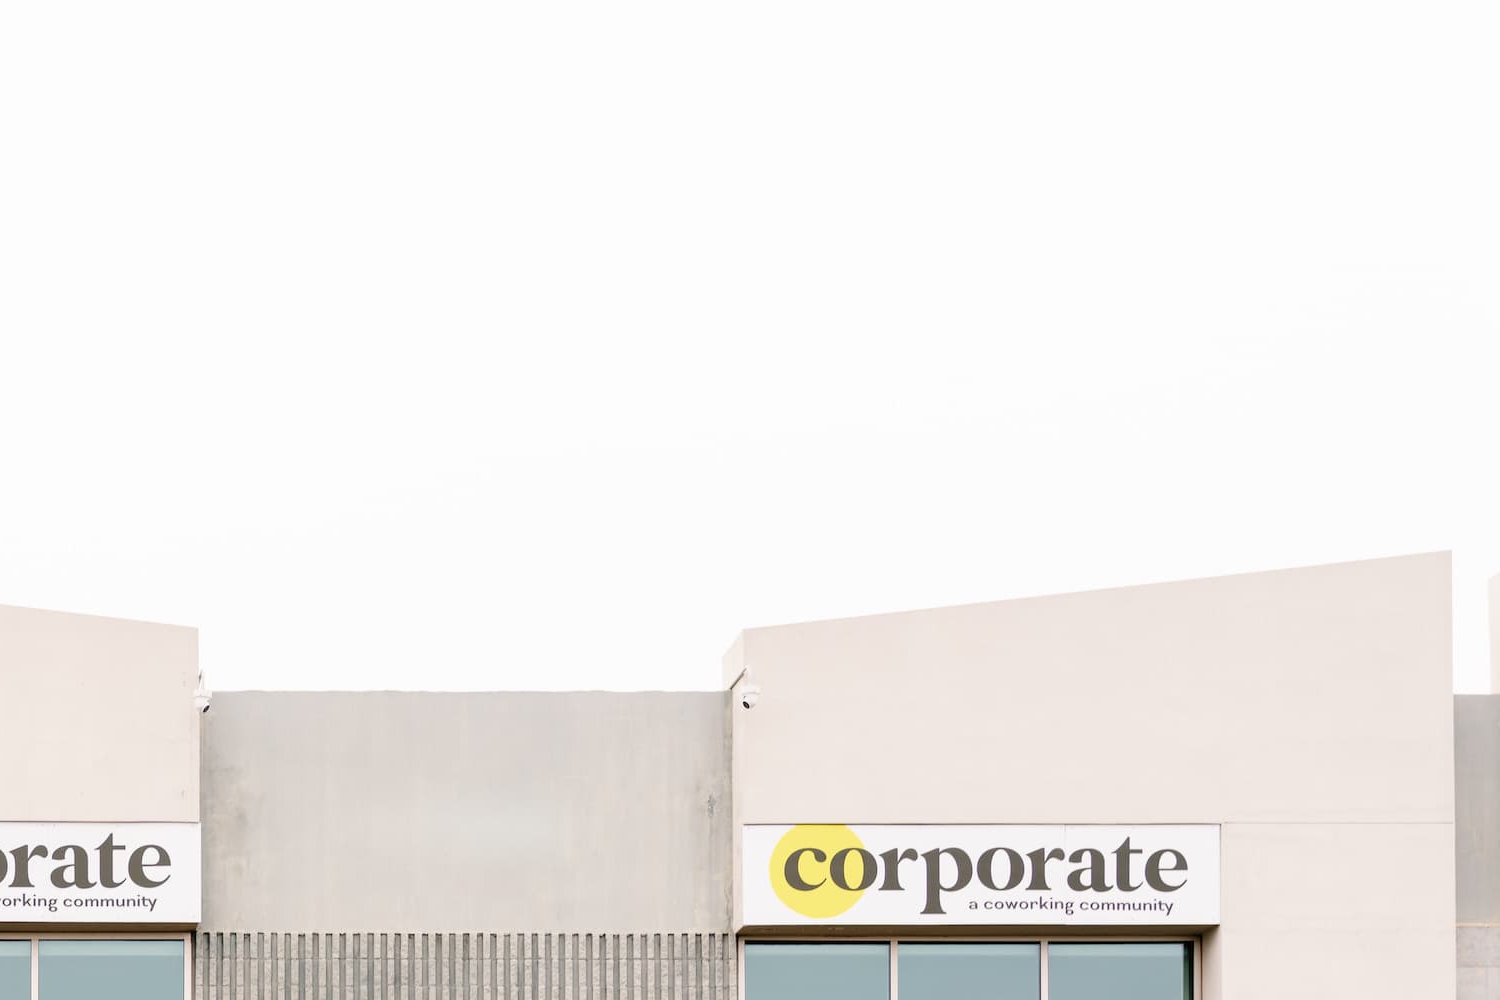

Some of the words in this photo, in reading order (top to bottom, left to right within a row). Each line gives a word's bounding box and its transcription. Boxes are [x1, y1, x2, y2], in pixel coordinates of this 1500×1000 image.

[784, 837, 1189, 915] corporate
[63, 894, 157, 912] community
[969, 901, 978, 910] a
[984, 896, 1074, 915] coworking
[1080, 897, 1174, 916] community
